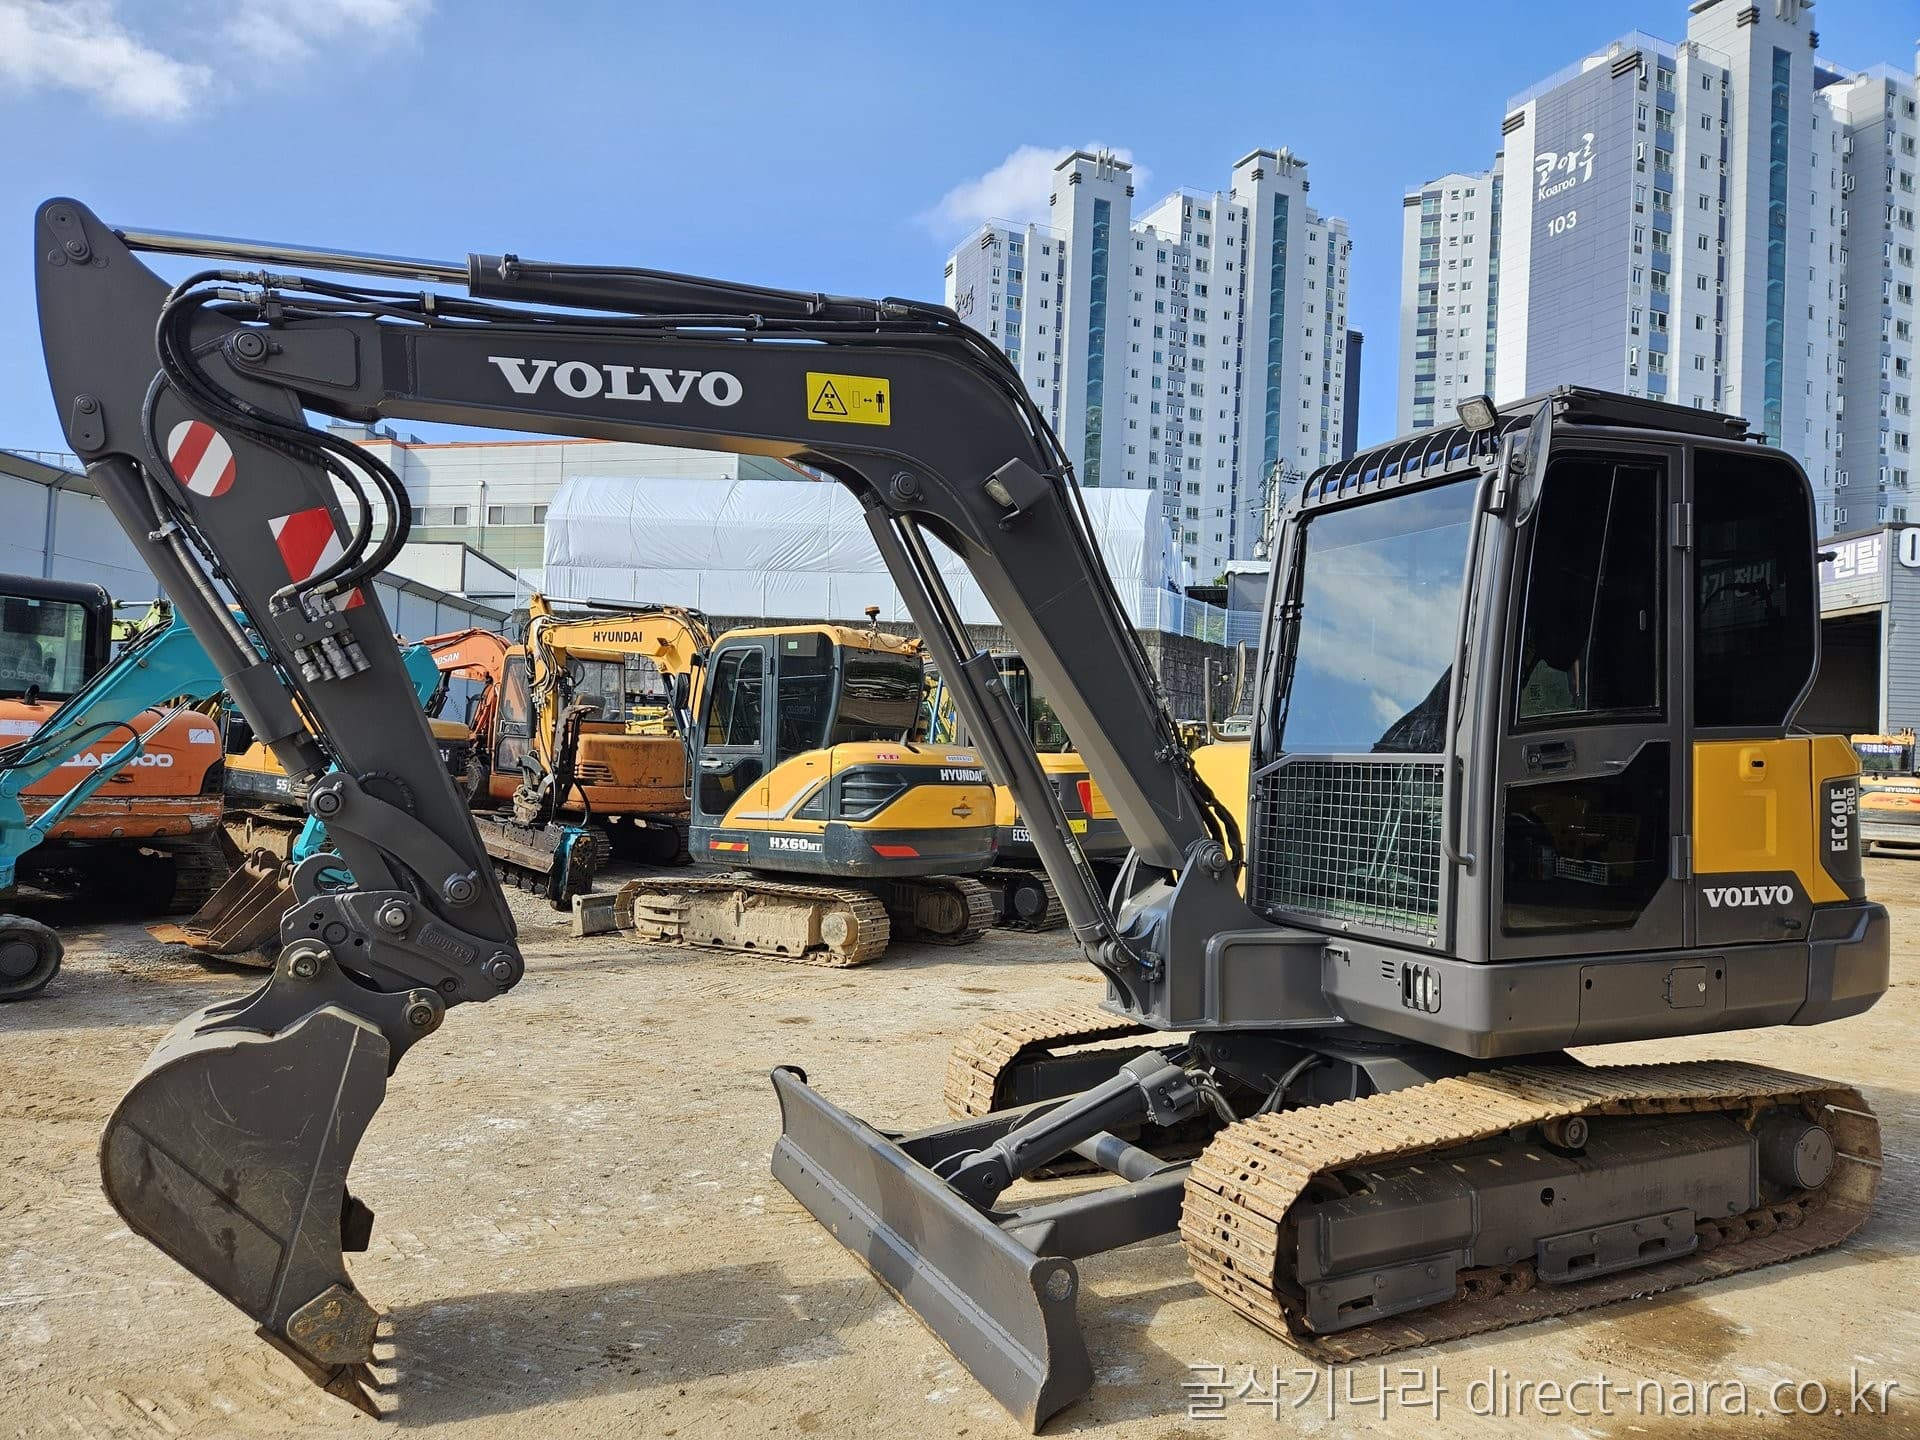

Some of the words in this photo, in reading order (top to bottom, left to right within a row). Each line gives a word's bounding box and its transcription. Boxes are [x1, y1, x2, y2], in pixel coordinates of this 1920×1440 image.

[1538, 176, 1576, 202] Koaroo
[1547, 210, 1577, 237] 103
[487, 355, 744, 407] VOLVO
[1833, 538, 1882, 579] 렌탈
[593, 631, 643, 643] HYUNDAI
[940, 769, 983, 782] HYUNDAI
[1846, 787, 1856, 815] PRO
[1831, 787, 1848, 852] EC60E
[1703, 885, 1794, 908] VOLVO
